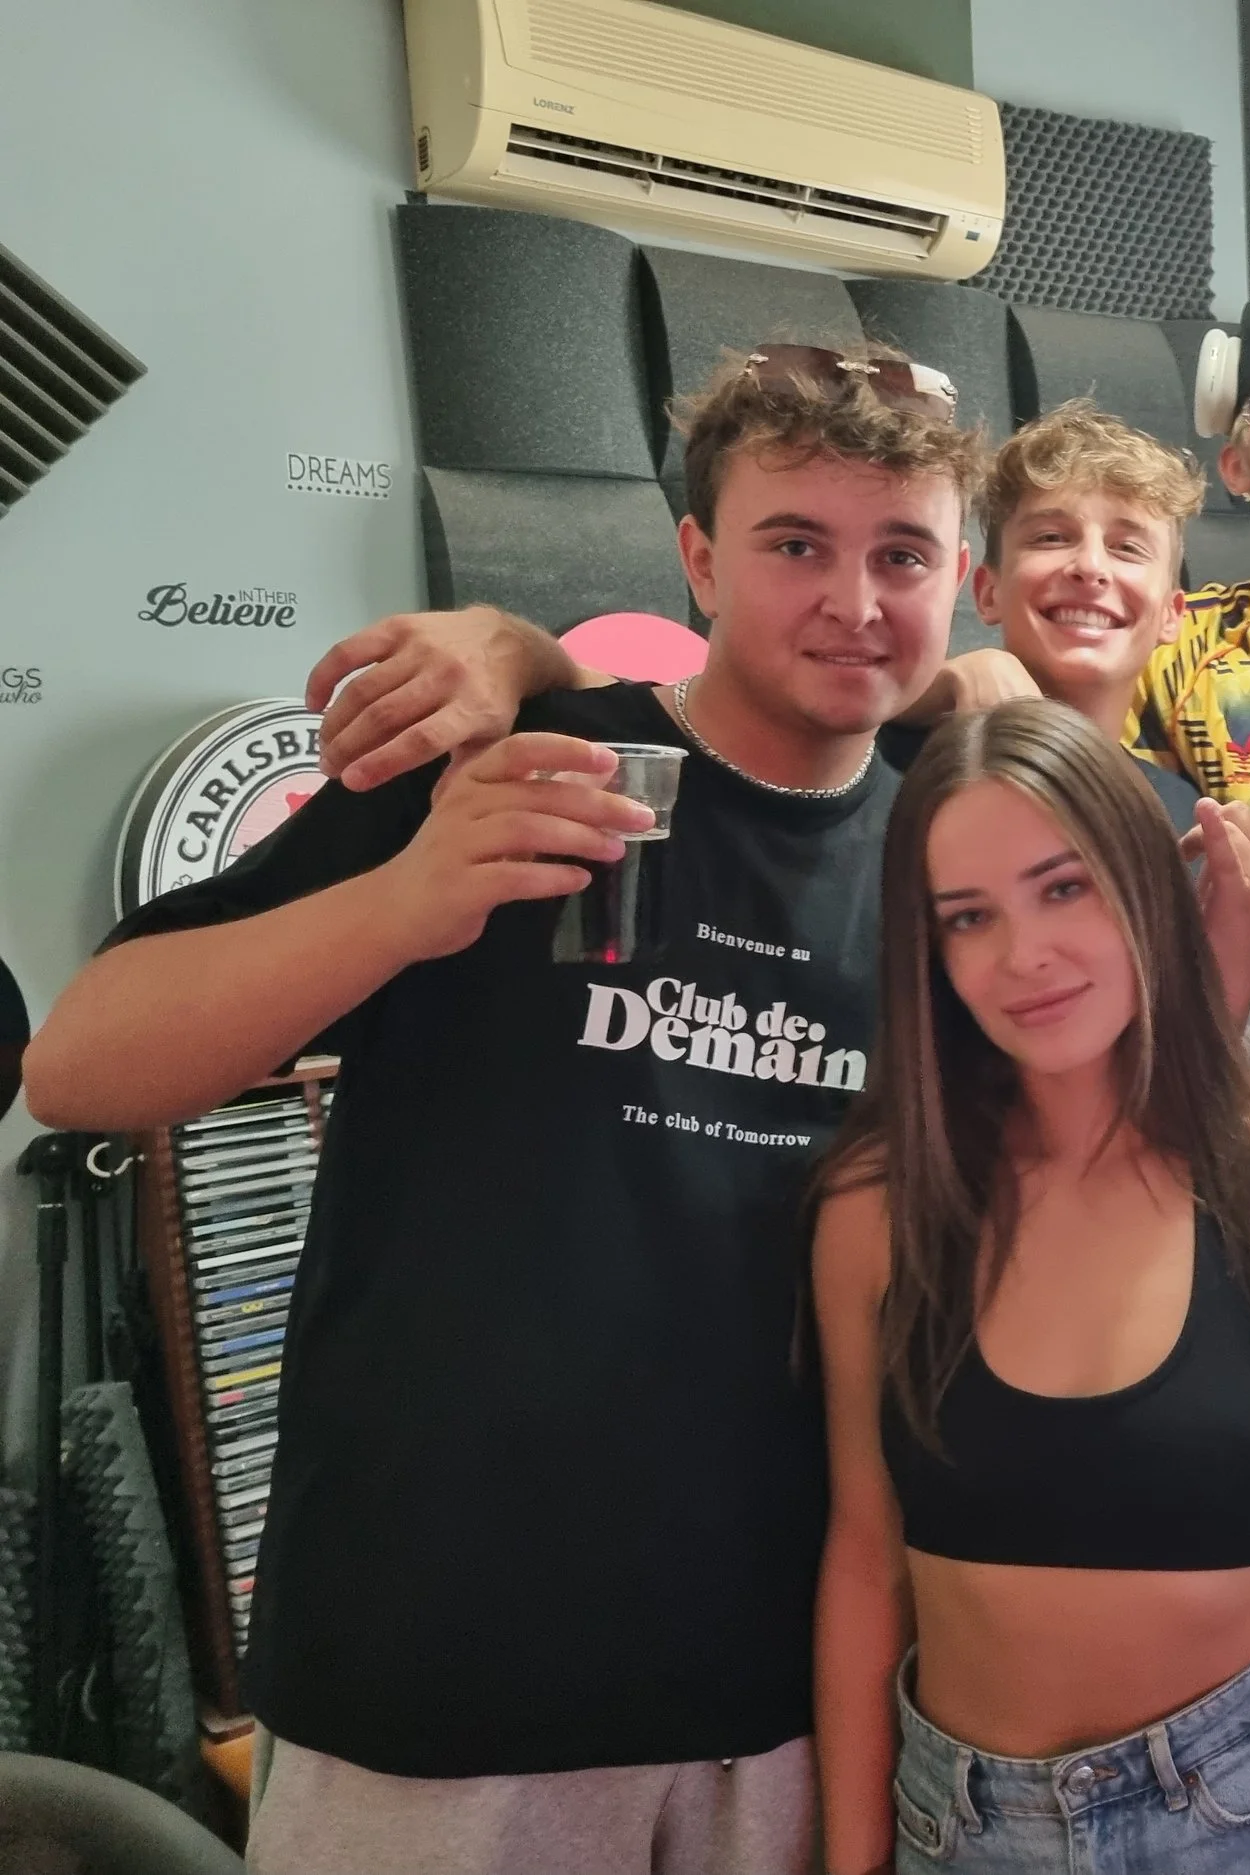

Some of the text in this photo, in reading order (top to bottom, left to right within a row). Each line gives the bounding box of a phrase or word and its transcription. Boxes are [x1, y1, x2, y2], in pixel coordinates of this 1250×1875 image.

[533, 96, 575, 115] LORENZ
[287, 453, 391, 489] DREAMS
[138, 582, 297, 628] Believe
[0, 667, 42, 689] GS
[177, 728, 320, 863] CARLSBE
[696, 922, 811, 961] Bienvenue au
[646, 976, 748, 1031] Club
[577, 982, 867, 1092] Demain
[622, 1104, 811, 1147] The club of Tomorrow
